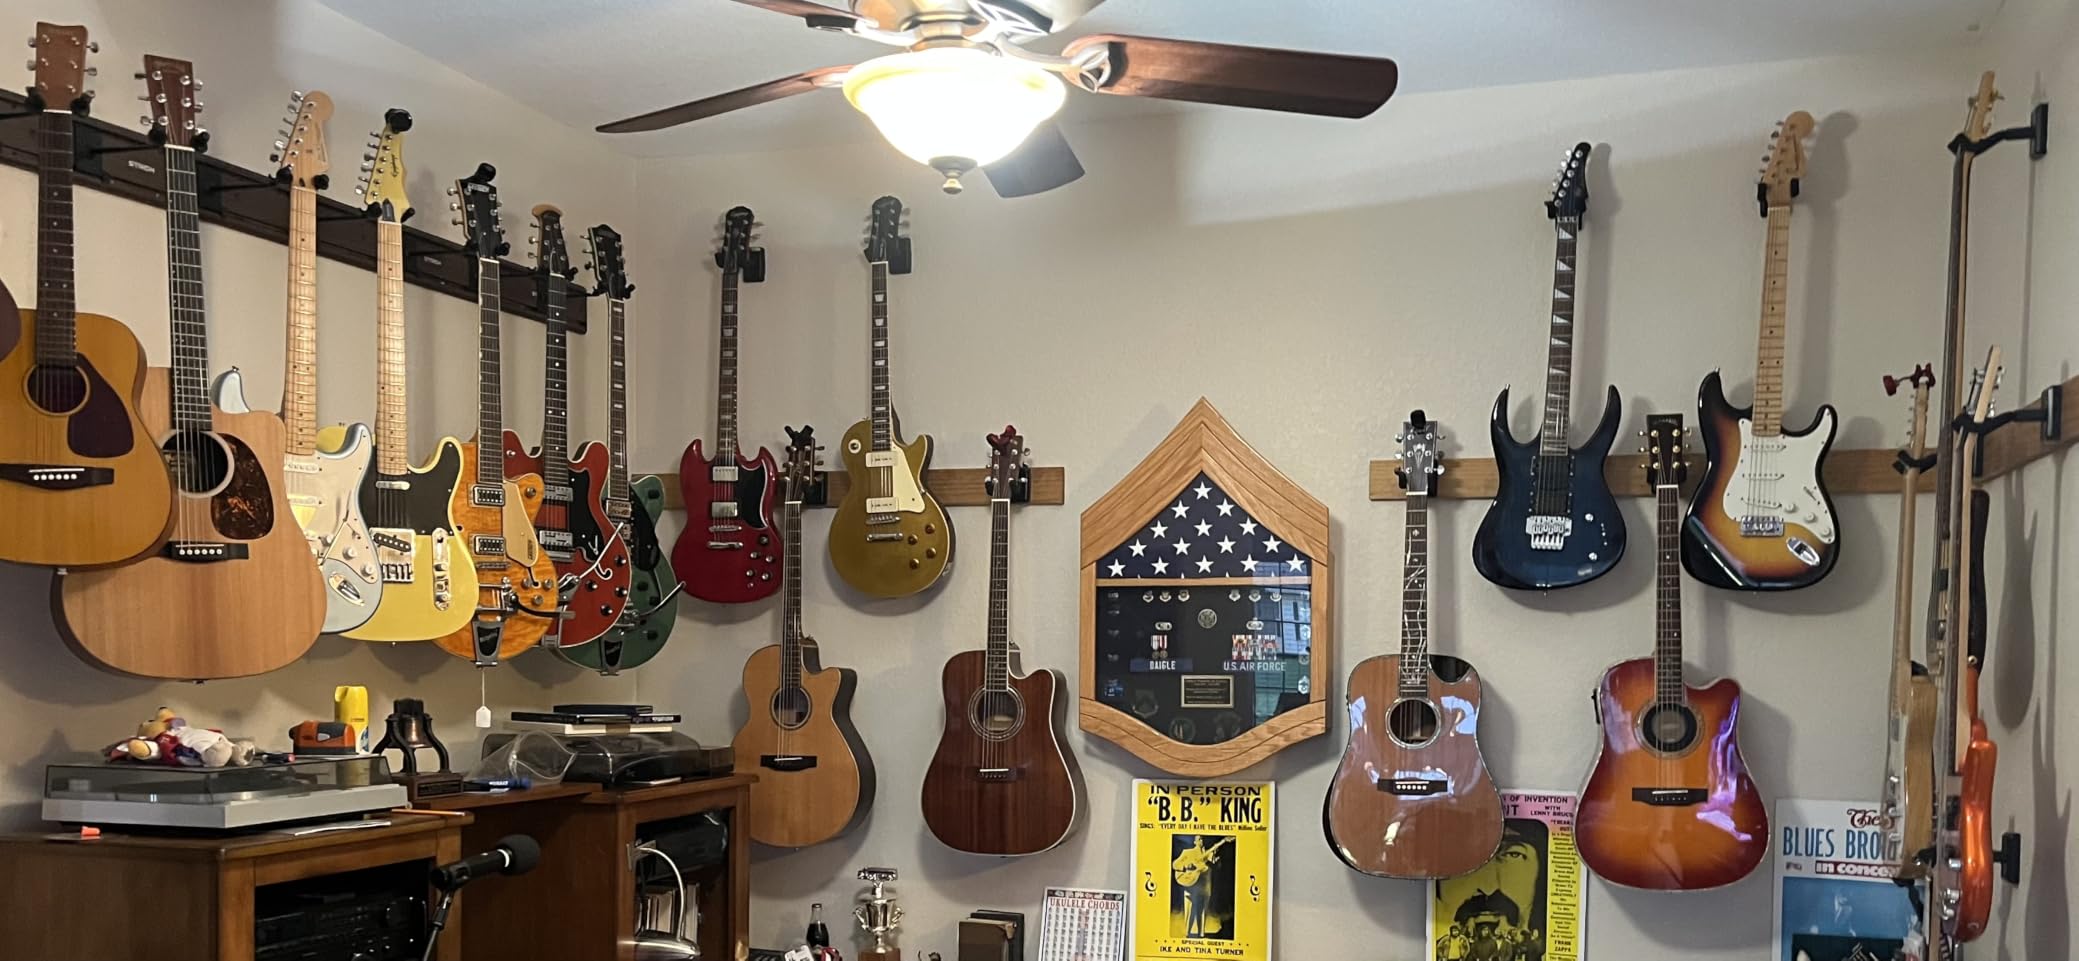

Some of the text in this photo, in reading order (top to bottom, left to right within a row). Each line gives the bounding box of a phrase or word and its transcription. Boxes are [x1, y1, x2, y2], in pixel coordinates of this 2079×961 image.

[1149, 660, 1176, 670] DAIGLE
[1240, 661, 1255, 671] AIR
[1257, 661, 1285, 671] FORCE
[1151, 785, 1260, 796] IN PERSON
[1524, 795, 1568, 804] INVENTION
[1221, 797, 1261, 823] KING
[1846, 808, 1881, 829] The
[1782, 827, 1881, 860] BLUES BRO
[1815, 861, 1834, 873] in
[1836, 862, 1890, 878] conce
[1050, 898, 1120, 910] UKULELE CHORDS
[1216, 948, 1244, 956] TURNER
